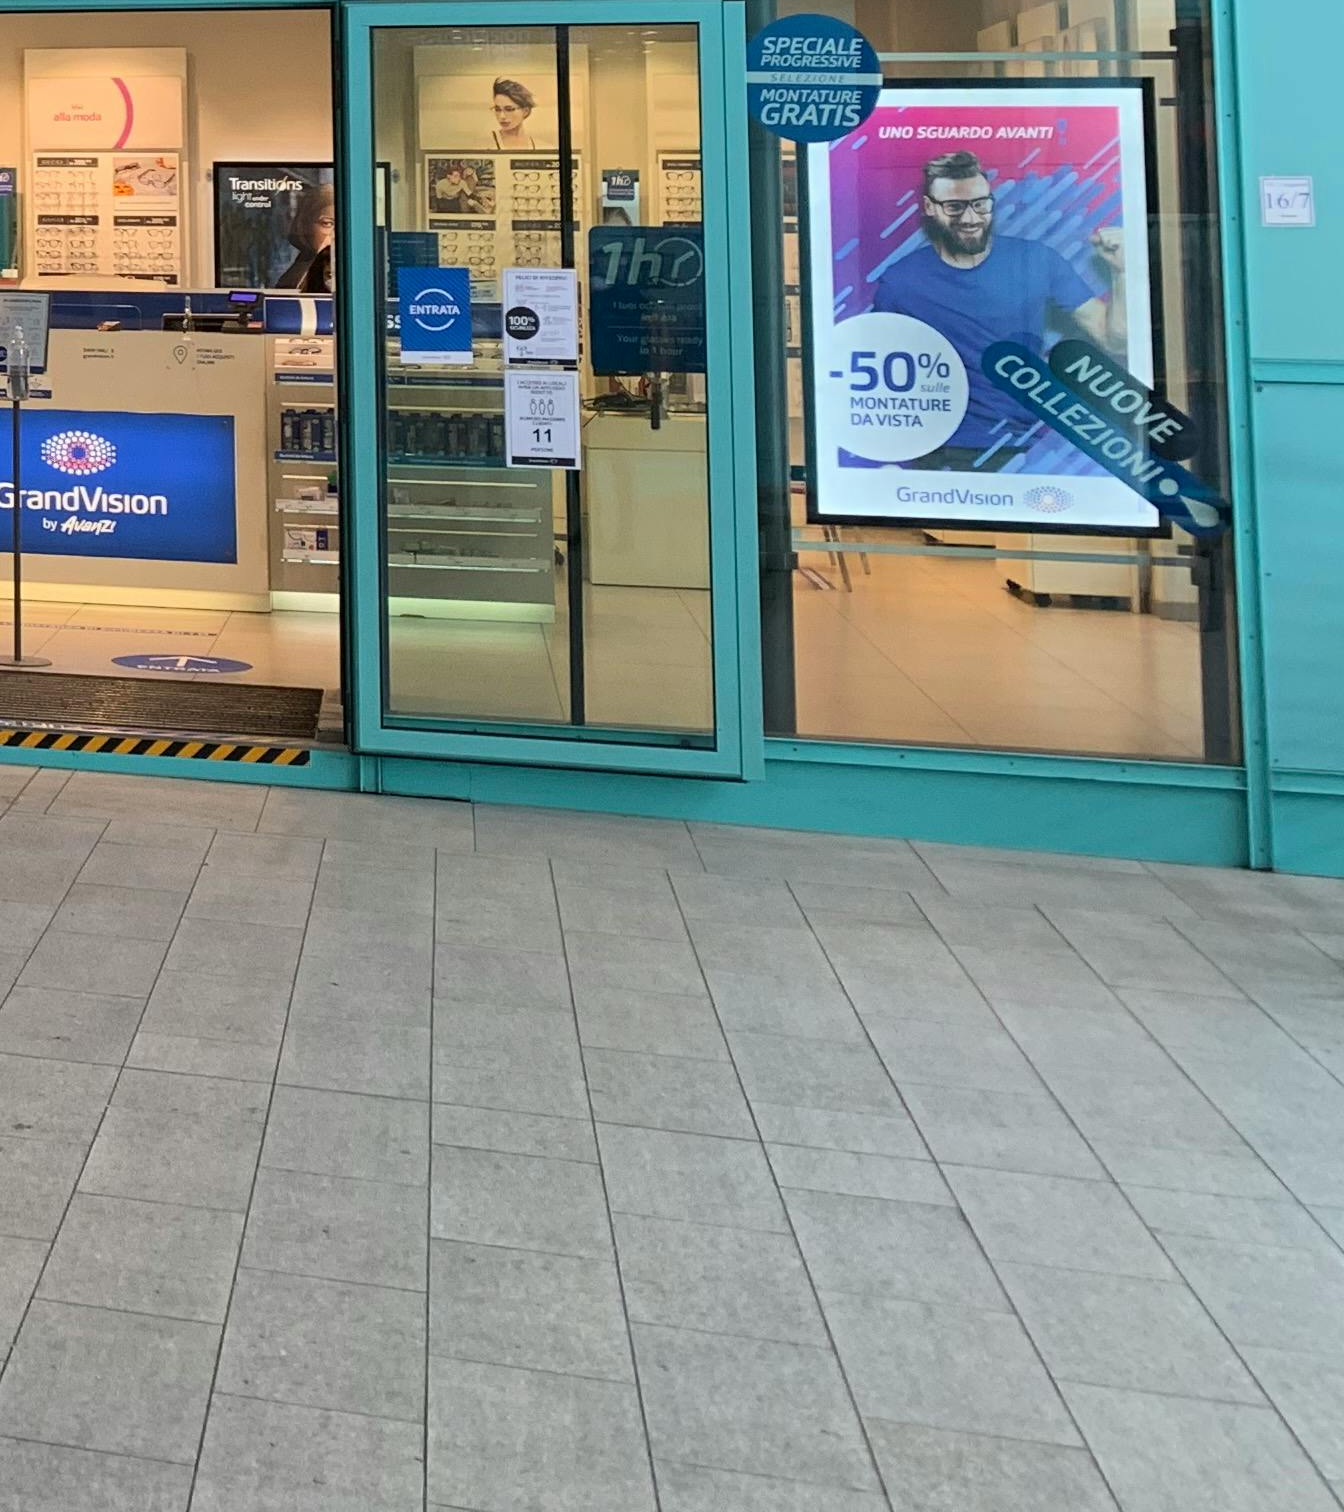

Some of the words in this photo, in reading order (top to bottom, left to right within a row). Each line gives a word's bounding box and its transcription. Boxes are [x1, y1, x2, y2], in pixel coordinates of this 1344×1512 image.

[761, 36, 864, 56] SPECIALE
[760, 54, 862, 68] PROGRESSIVE
[770, 73, 846, 83] SELEZIONE
[759, 89, 862, 104] MONTATURE
[760, 103, 862, 127] GRATIS
[878, 126, 913, 139] UNO
[916, 126, 993, 139] SGUARDO
[995, 126, 1054, 139] AVANTI
[228, 176, 304, 193] Transitions
[1266, 192, 1311, 209] 16/7
[409, 304, 461, 316] ENTRATA
[508, 315, 536, 327] 100%
[828, 350, 951, 394] -50%
[919, 382, 951, 394] sulle
[850, 396, 952, 413] MONTATURE
[1064, 354, 1185, 445] NUOVE
[850, 413, 874, 428] DA
[876, 413, 925, 428] VISTA
[993, 353, 1166, 485] COLLEZIONI
[532, 428, 552, 443] 11
[896, 485, 1014, 508] GrandVision
[42, 517, 58, 532] by
[60, 515, 117, 536] Avanzi
